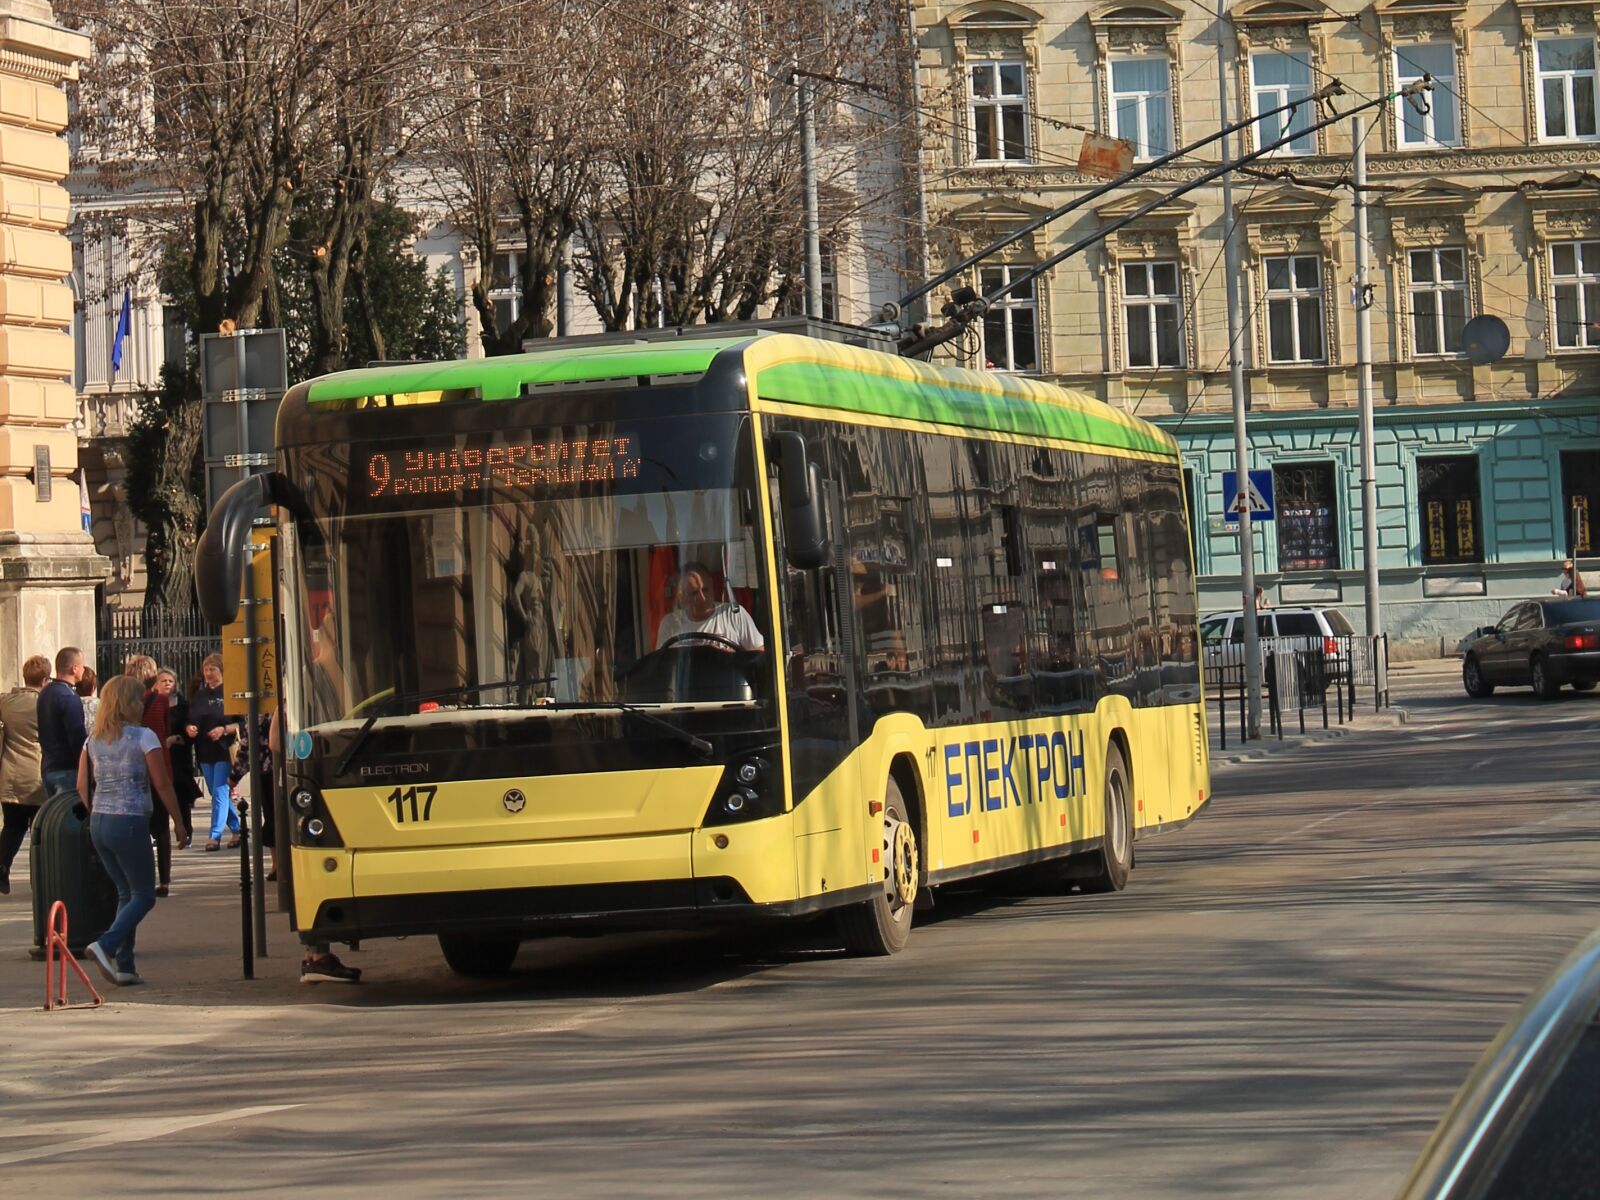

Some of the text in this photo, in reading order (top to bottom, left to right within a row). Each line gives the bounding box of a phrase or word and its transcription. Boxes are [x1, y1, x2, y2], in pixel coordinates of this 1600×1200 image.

[369, 437, 630, 497] 9 Університет
[360, 763, 429, 777] ELECTRON
[944, 729, 1087, 818] ЕЛЕКТРОН
[387, 785, 438, 824] 117
